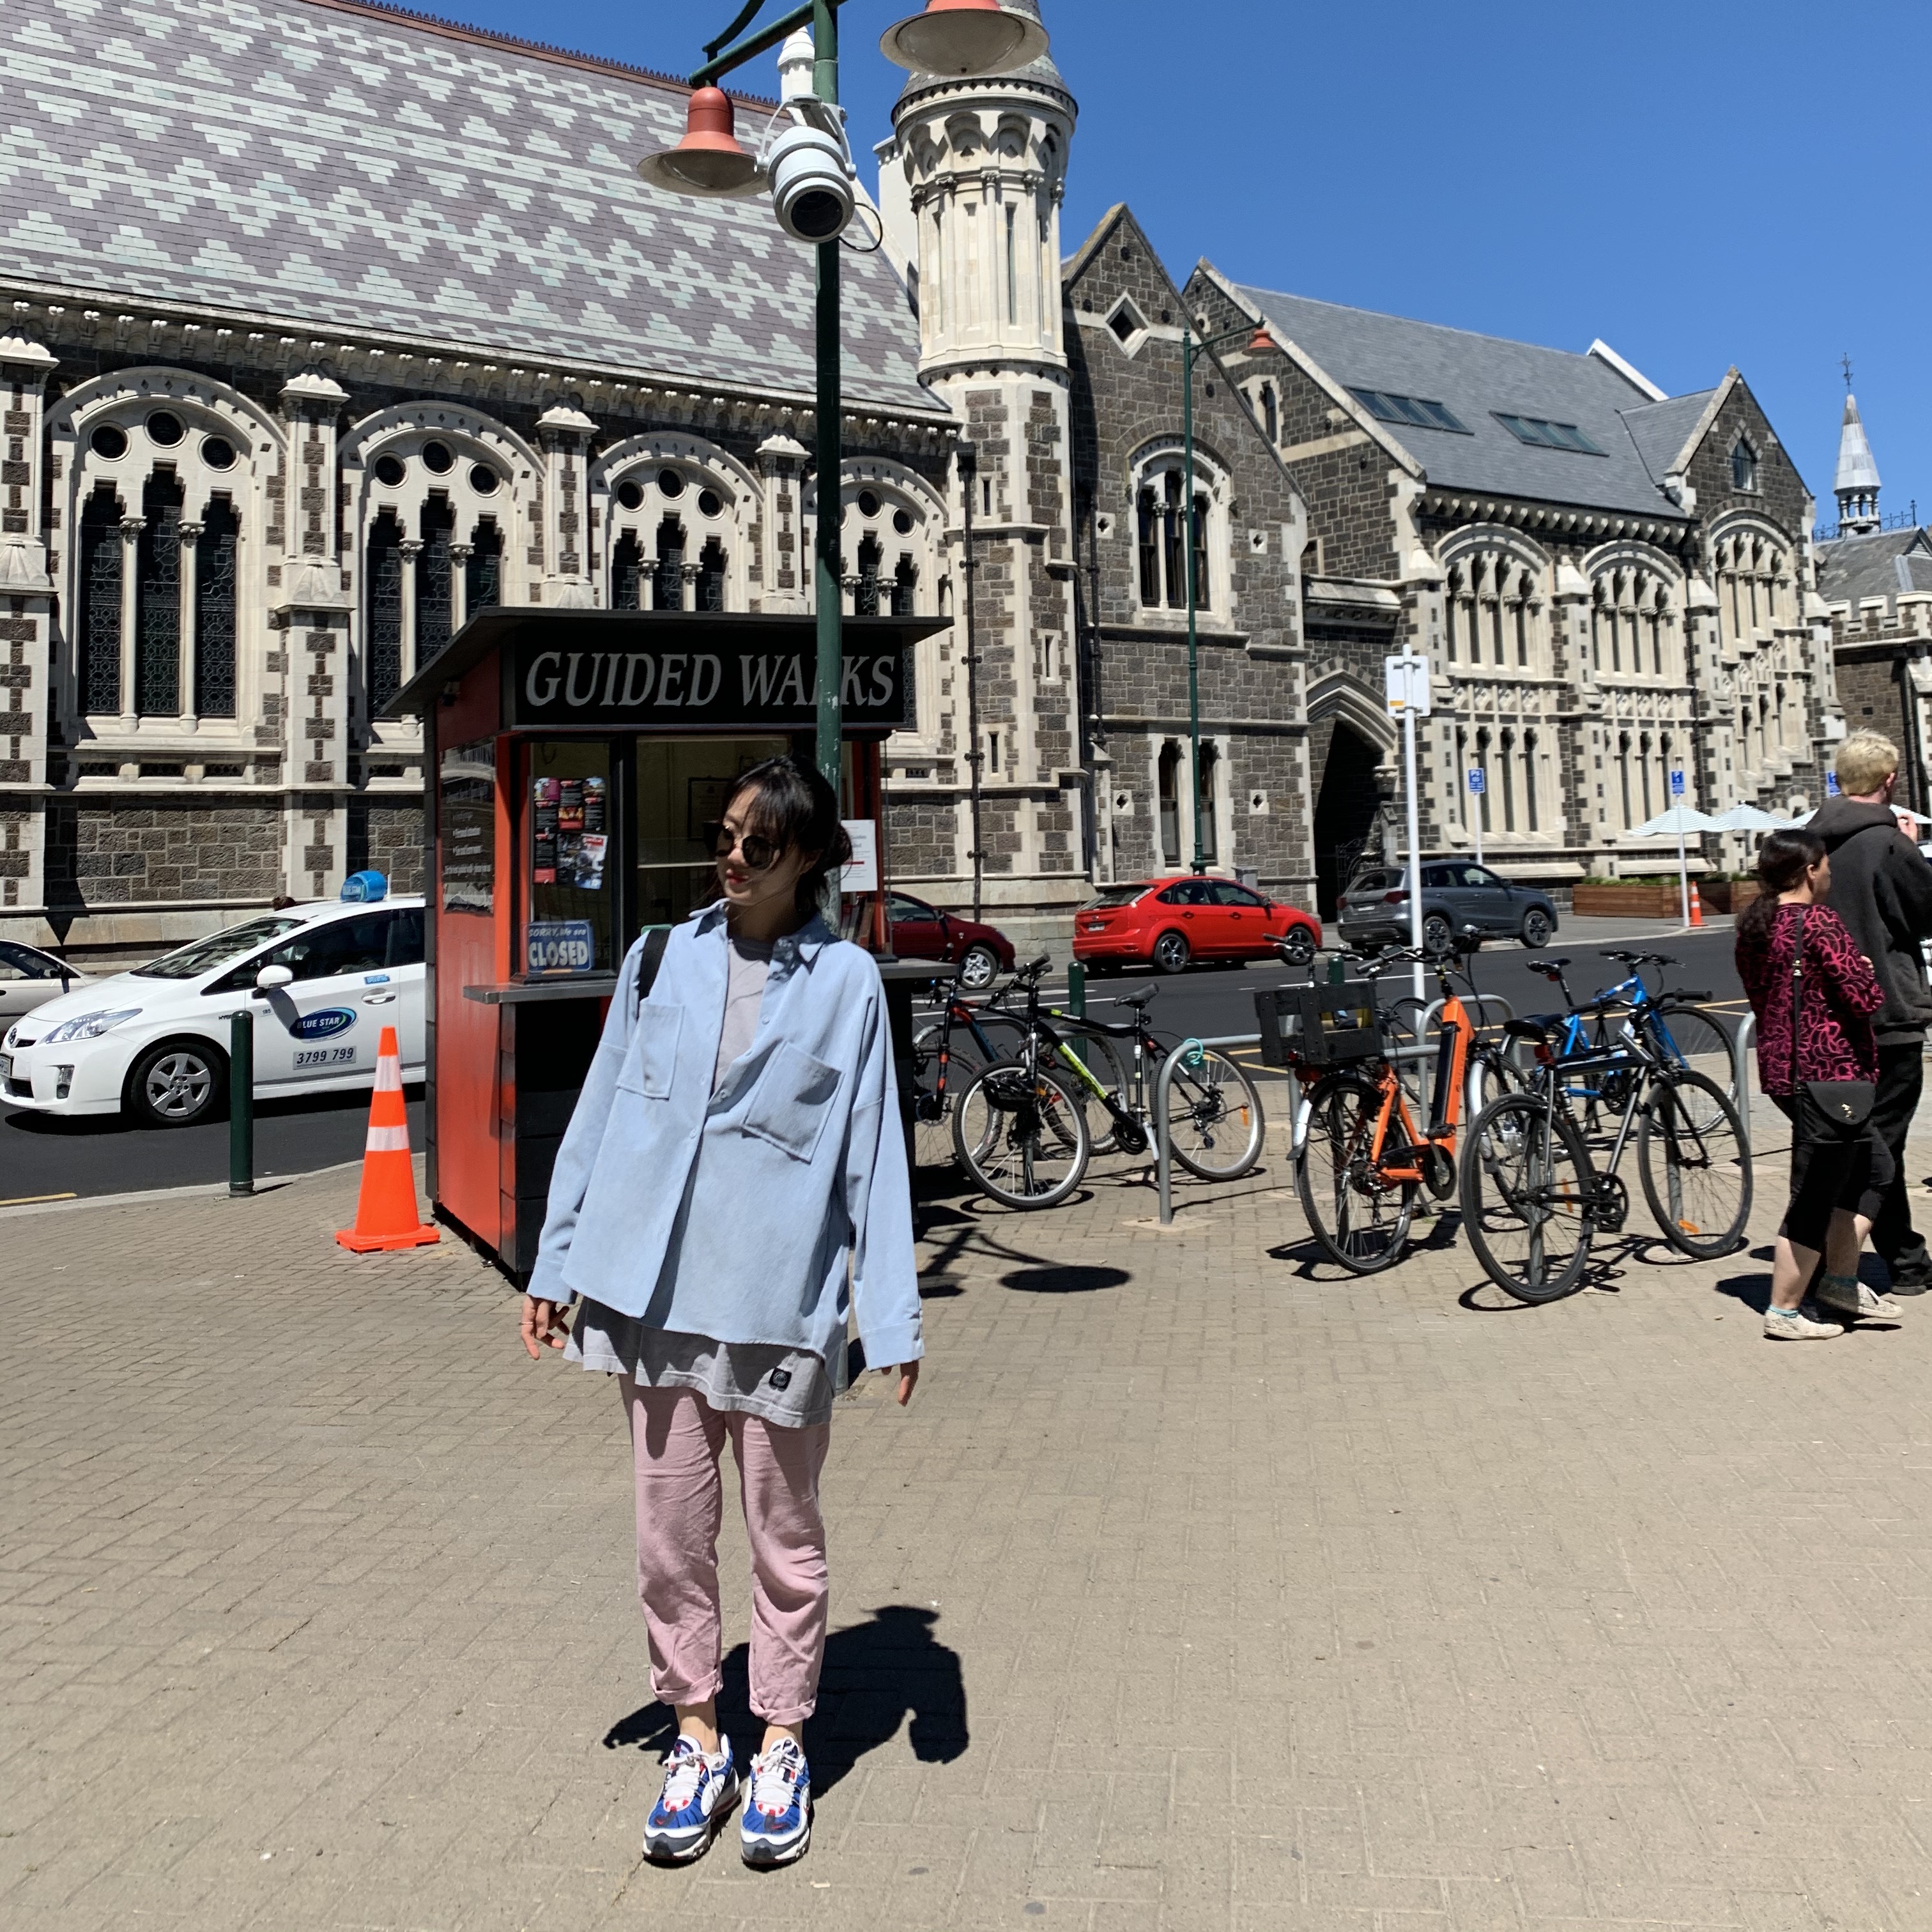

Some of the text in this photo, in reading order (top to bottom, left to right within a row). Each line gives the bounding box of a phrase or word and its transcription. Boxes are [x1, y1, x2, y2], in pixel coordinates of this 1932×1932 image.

[525, 651, 895, 707] GUIDED WAKS
[528, 940, 588, 967] CLOSED
[296, 1016, 340, 1029] BLUE STAR
[296, 1050, 327, 1065] 3799
[332, 1047, 354, 1061] 799
